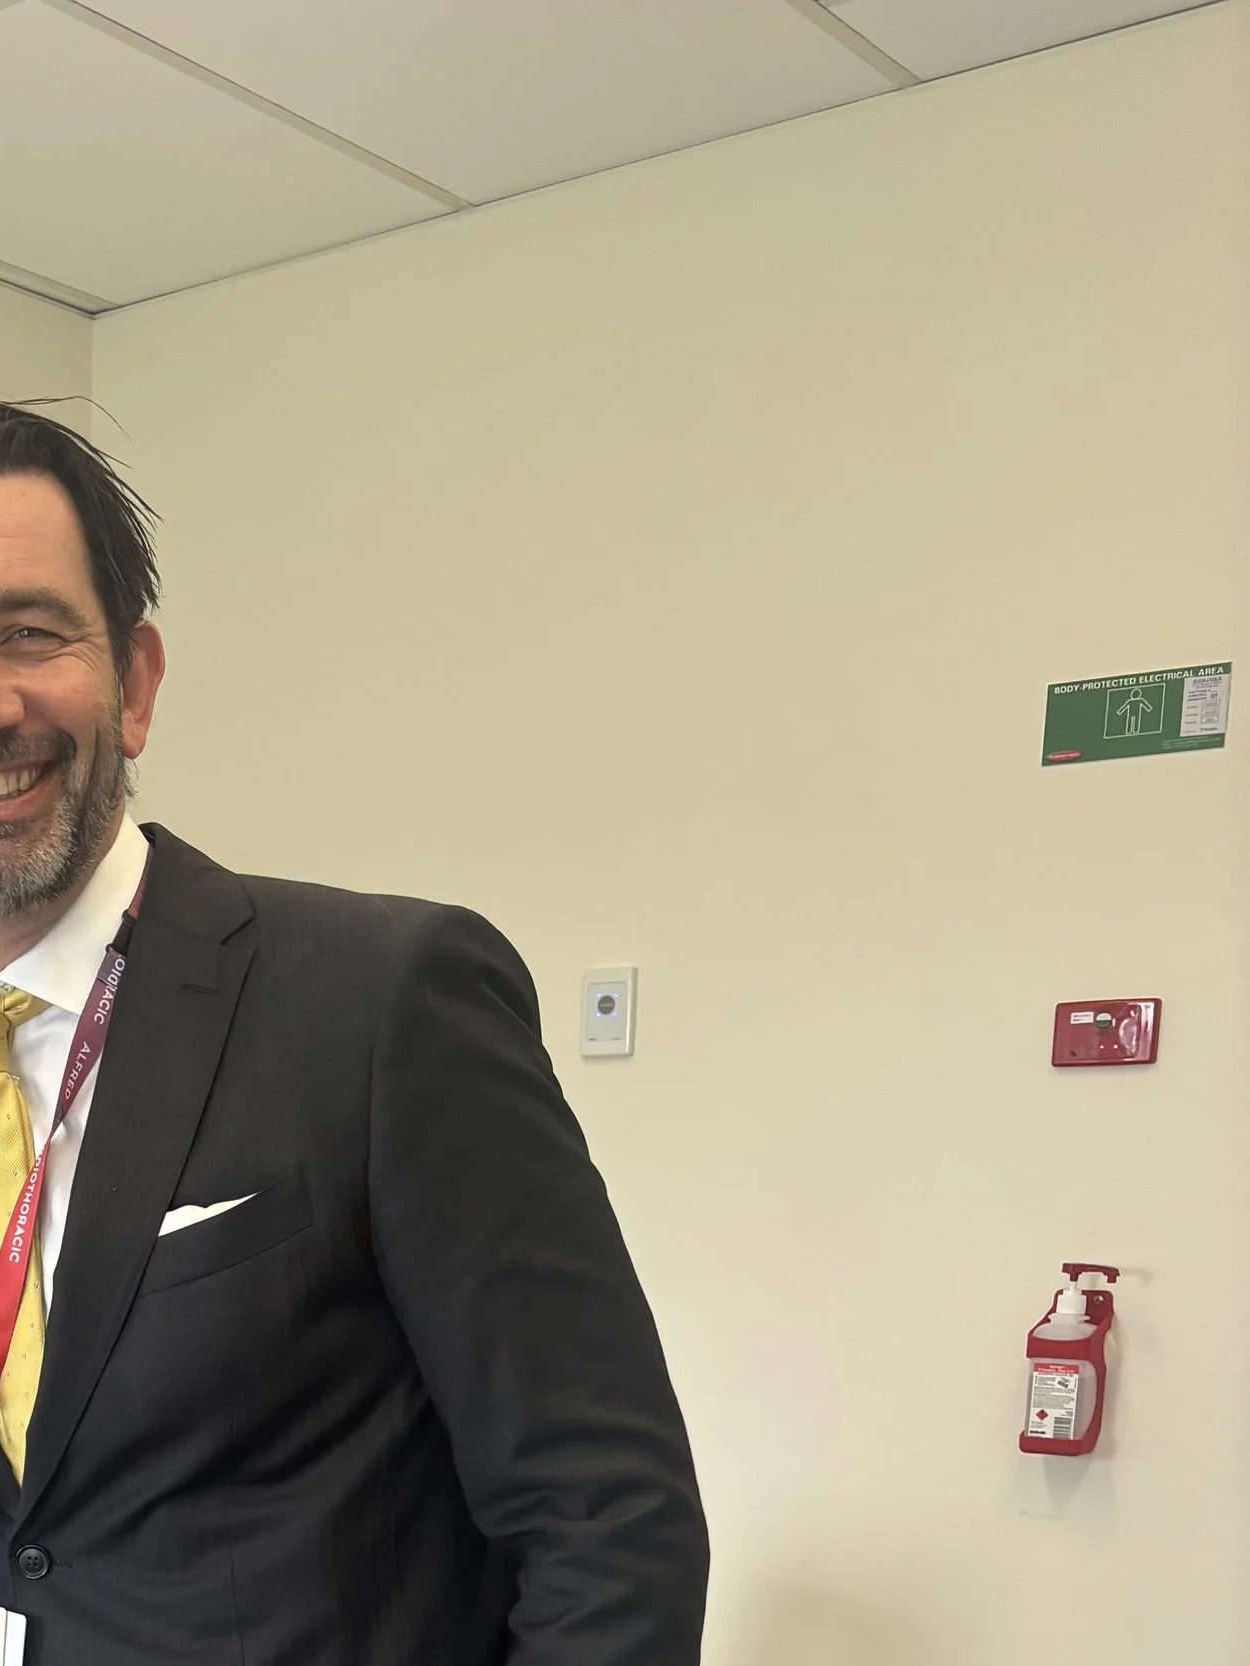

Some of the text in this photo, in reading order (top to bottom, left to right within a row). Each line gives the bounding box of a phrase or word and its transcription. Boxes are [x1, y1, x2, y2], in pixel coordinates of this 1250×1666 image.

[1054, 677, 1137, 694] BODY-PROTECTED
[1139, 670, 1194, 684] ELECTRICAL
[1198, 667, 1224, 676] AREA
[65, 1041, 91, 1100] ALFRED
